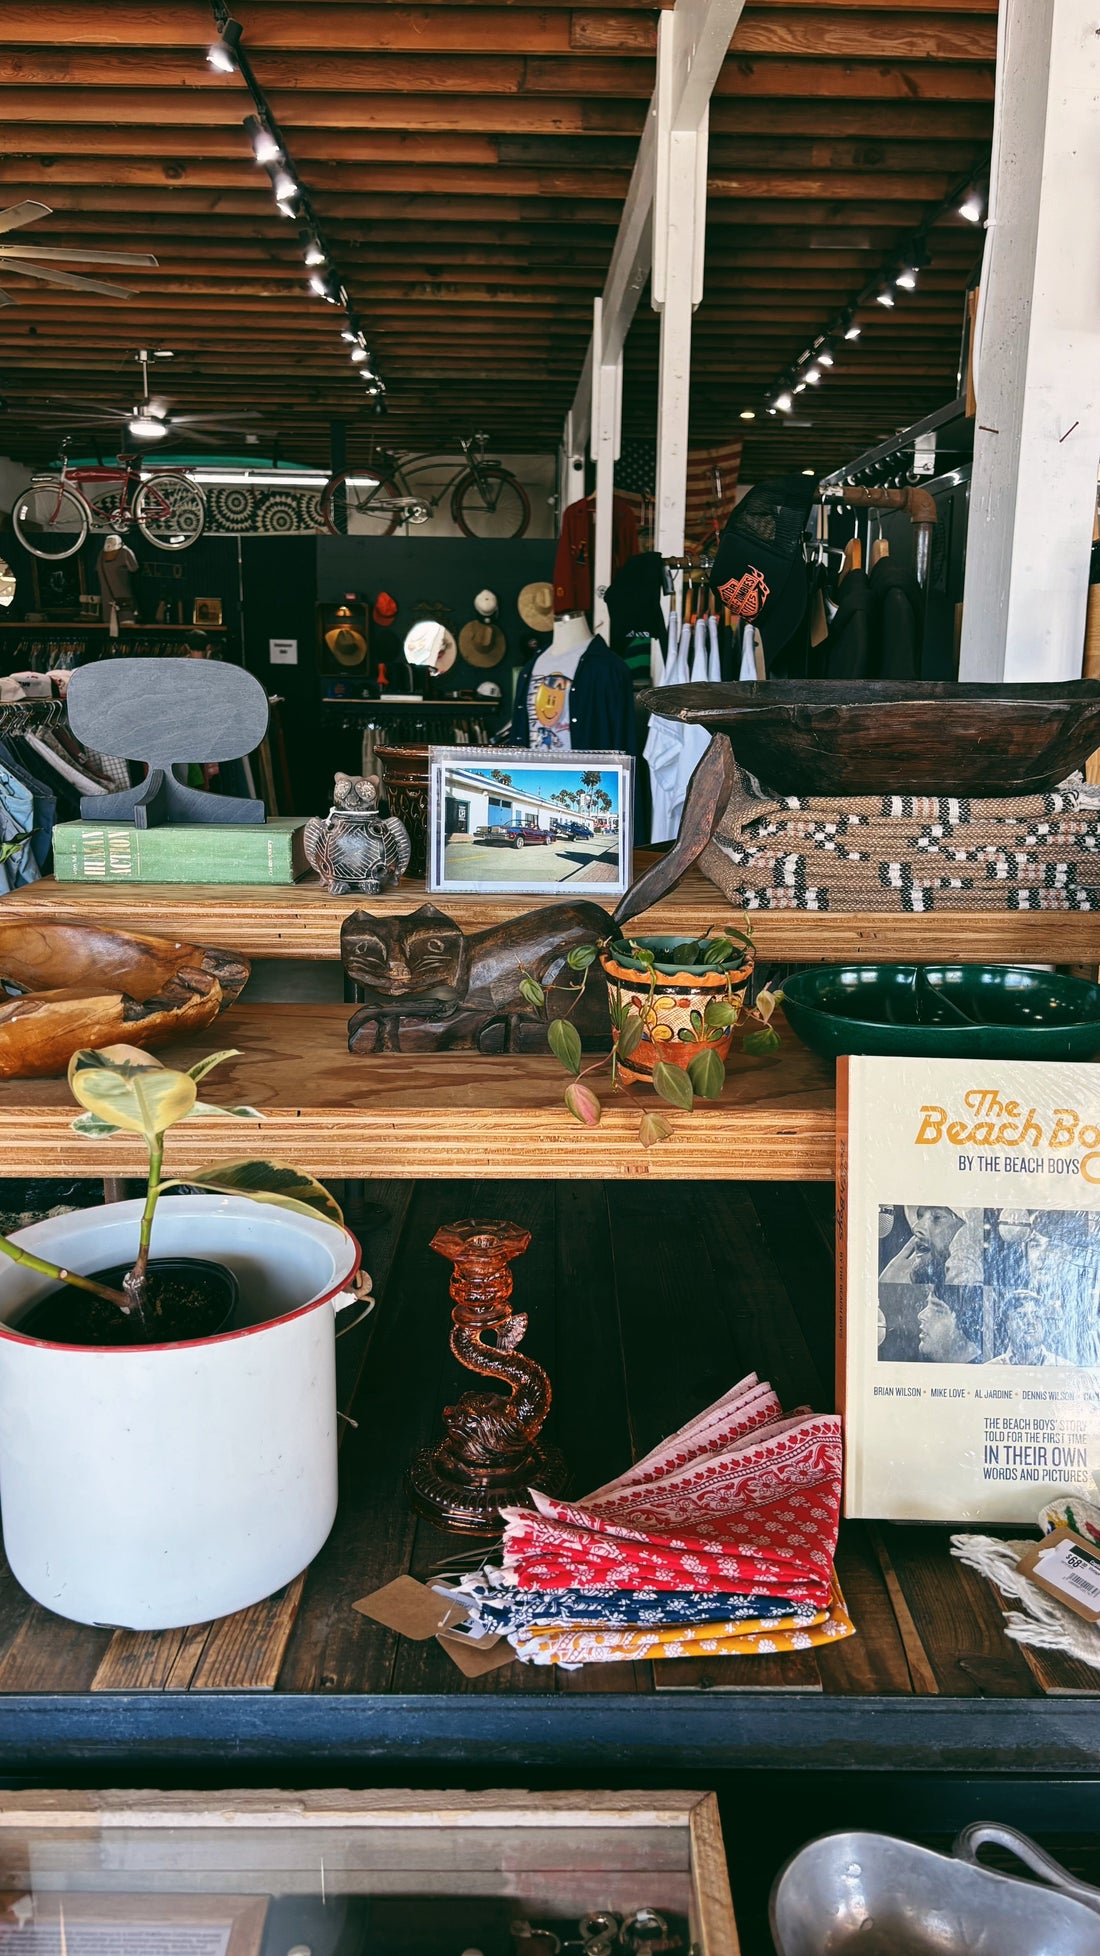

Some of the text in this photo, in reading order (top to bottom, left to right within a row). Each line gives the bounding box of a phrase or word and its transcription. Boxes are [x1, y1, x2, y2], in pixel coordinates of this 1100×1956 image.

[81, 831, 106, 876] HUMAN
[108, 830, 132, 876] ACTION
[964, 1089, 1022, 1119] The
[914, 1105, 1100, 1149] Beach Bo
[958, 1155, 1080, 1175] BY THE BEACH BOYS
[873, 1386, 894, 1397] BRIAN
[894, 1387, 922, 1397] WILSON
[930, 1388, 947, 1398] MIKE
[948, 1388, 966, 1398] LOVE
[974, 1389, 983, 1399] AL
[984, 1389, 1013, 1400] JARDINE
[1022, 1390, 1048, 1401] DENNIS
[1048, 1391, 1075, 1401] WILSON
[983, 1417, 1087, 1432] THE BEACH BOYS' STORY
[983, 1431, 1087, 1445] TOLD FOR THE FIRST TIME
[984, 1445, 1087, 1468] IN THEIR OWN
[983, 1467, 1089, 1483] WORDS AND PICTURES
